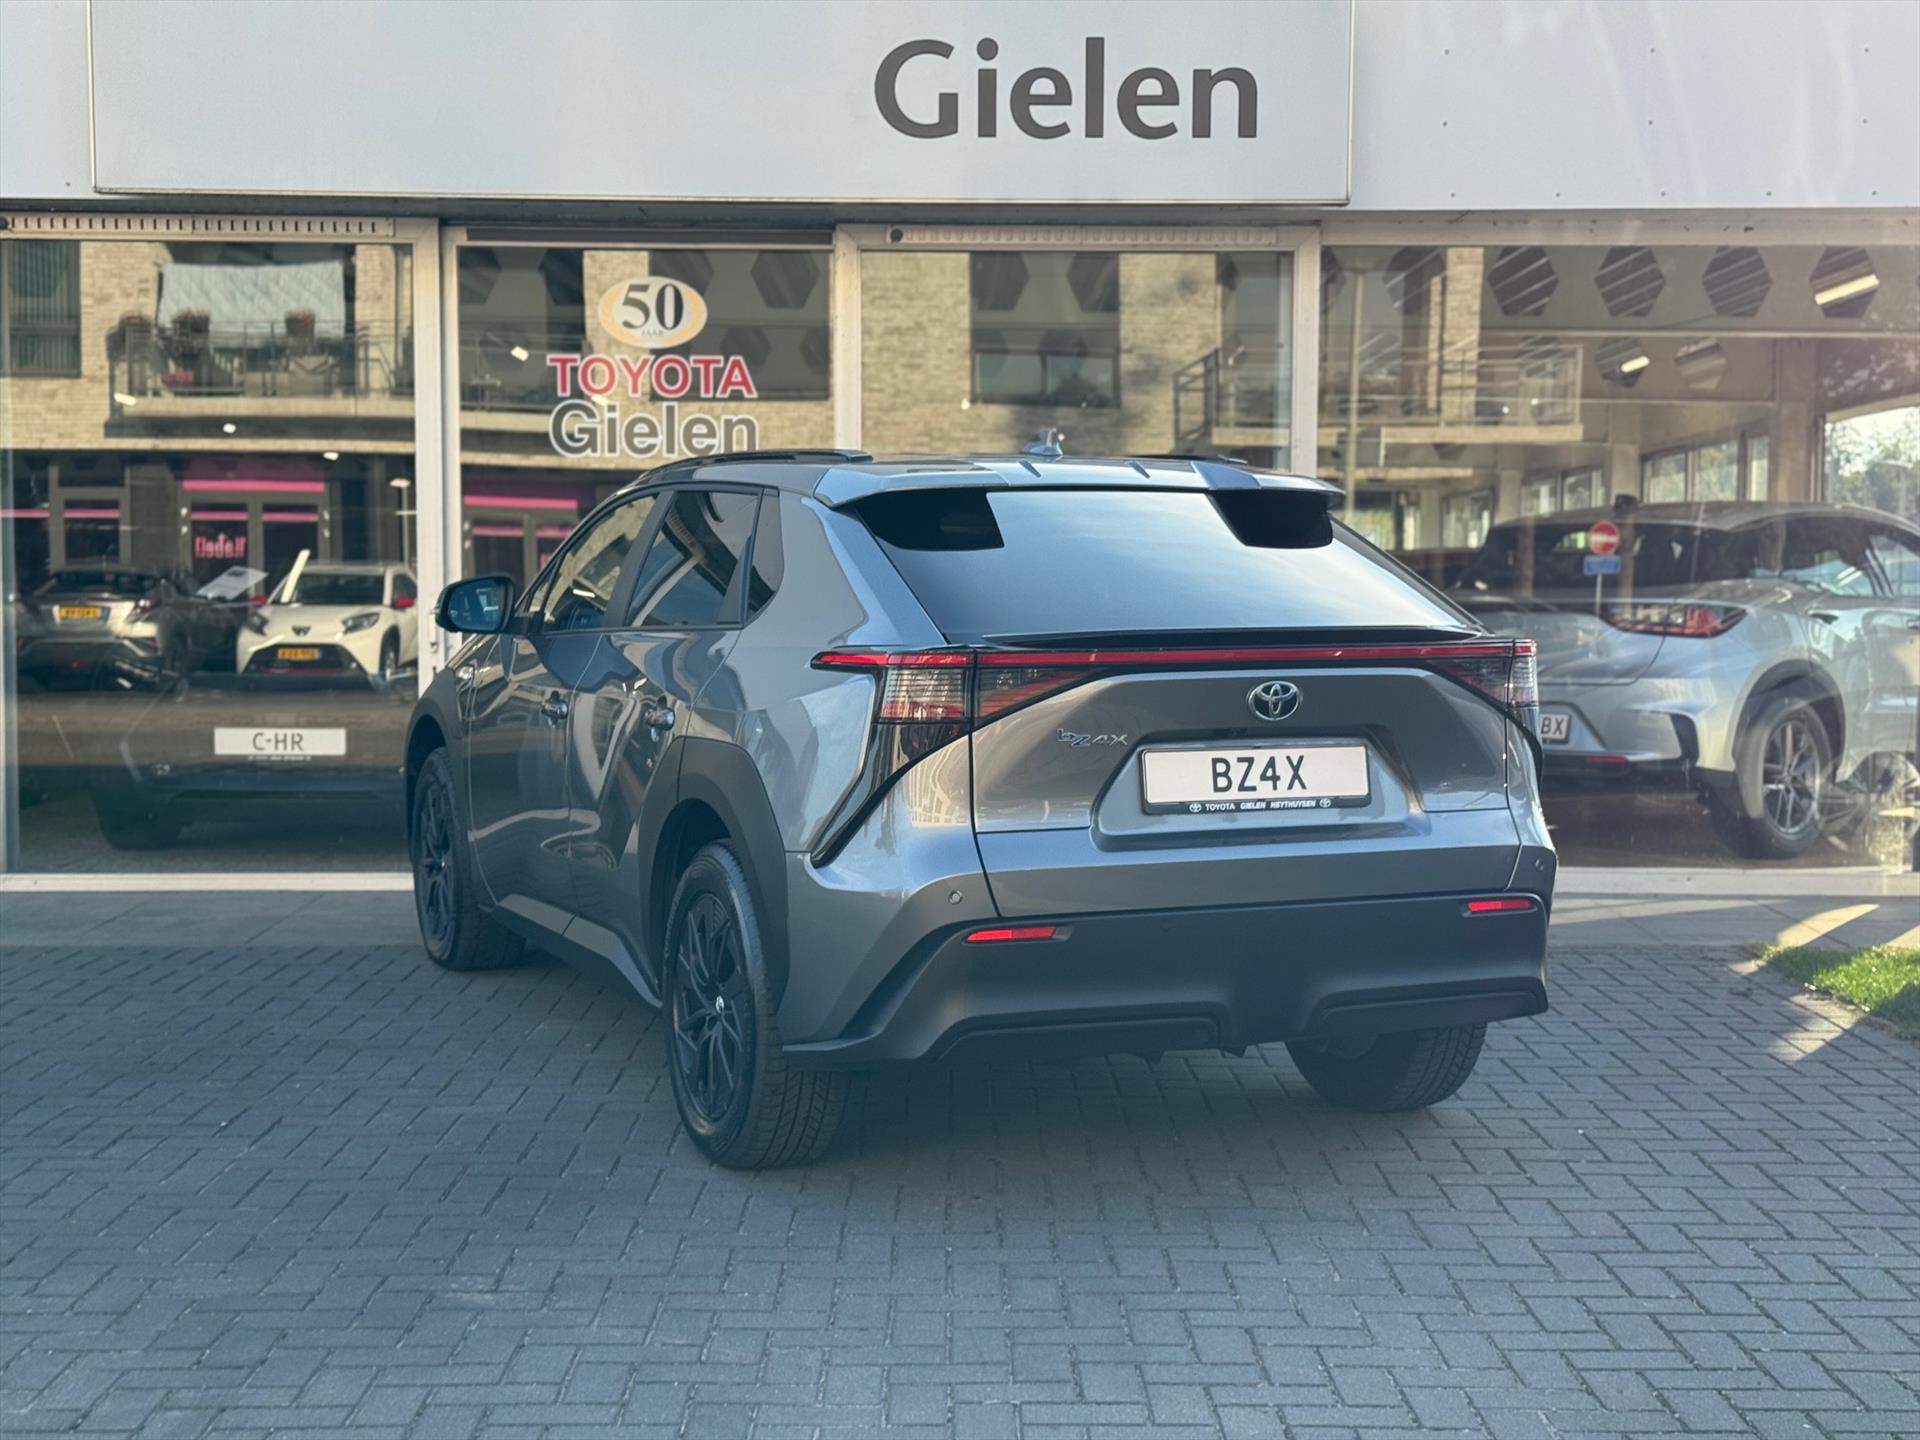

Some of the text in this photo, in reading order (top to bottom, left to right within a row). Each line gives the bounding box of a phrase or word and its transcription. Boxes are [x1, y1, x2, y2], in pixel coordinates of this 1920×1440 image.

[874, 36, 1258, 140] Gielen
[621, 283, 684, 330] 50
[640, 328, 665, 337] JAAR
[547, 354, 758, 398] TOYOTA
[549, 399, 759, 458] Gielen
[252, 732, 304, 752] C-HR
[1211, 754, 1308, 794] BZ4X
[1205, 802, 1236, 811] TOYOTA
[1240, 801, 1267, 810] GIELEN
